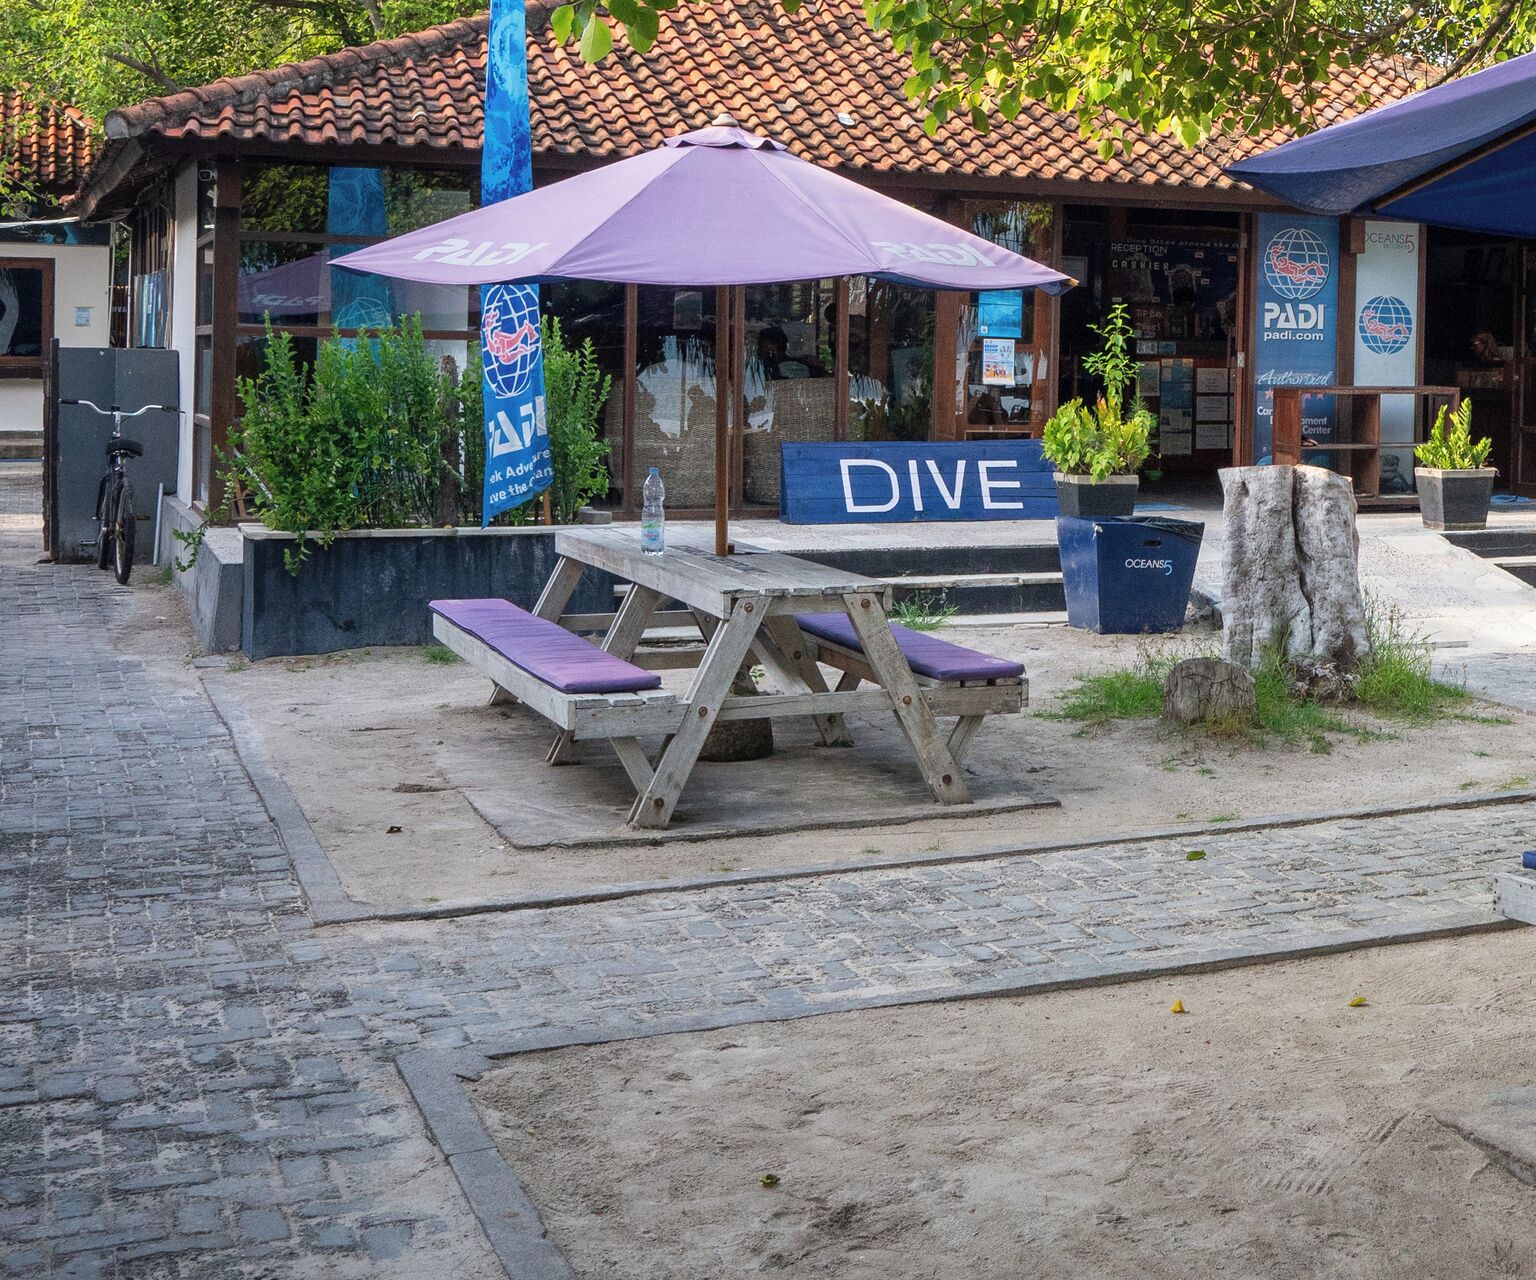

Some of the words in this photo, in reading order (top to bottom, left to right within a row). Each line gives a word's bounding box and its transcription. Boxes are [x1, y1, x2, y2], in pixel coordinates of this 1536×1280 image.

[412, 238, 550, 266] PADI
[870, 241, 997, 267] PADI
[1111, 243, 1168, 254] RECEPTION
[1112, 260, 1169, 271] CASHIER
[1264, 302, 1324, 330] PADI
[1264, 330, 1324, 341] padi.com
[1257, 369, 1334, 386] Authorized
[1302, 425, 1332, 435] Center
[839, 458, 1024, 513] DIVE
[1125, 558, 1173, 576] OCEANS5
